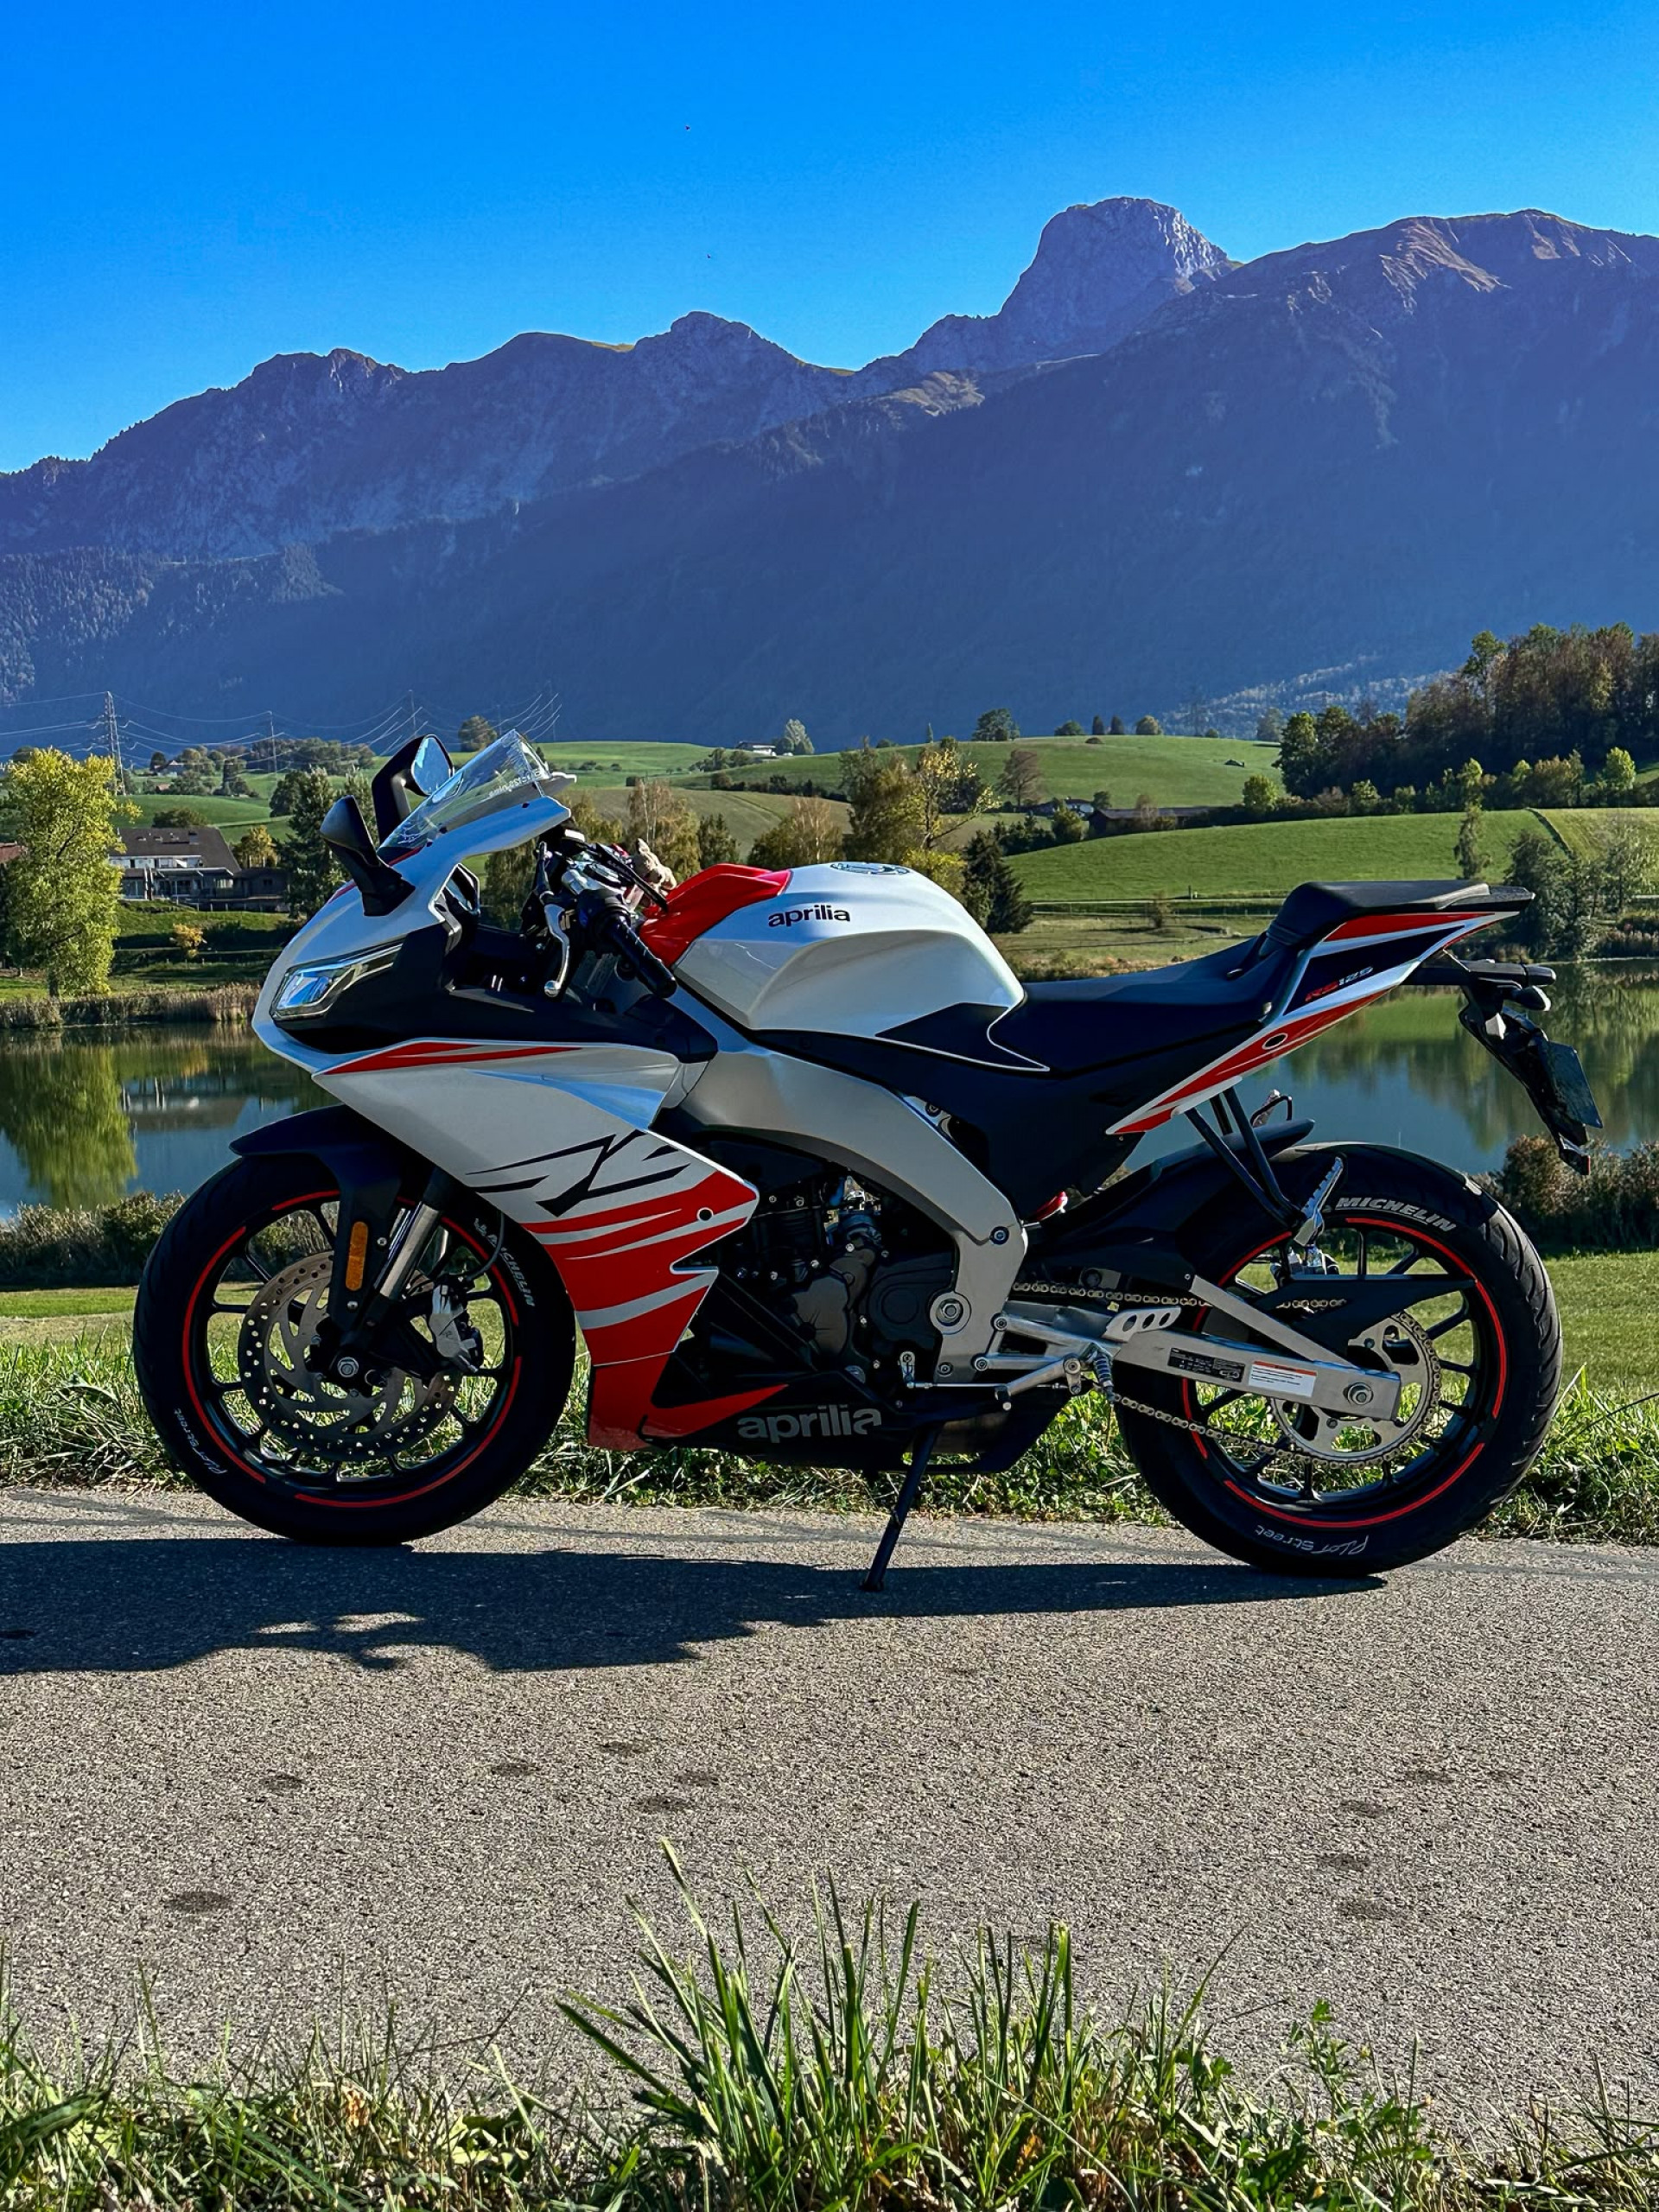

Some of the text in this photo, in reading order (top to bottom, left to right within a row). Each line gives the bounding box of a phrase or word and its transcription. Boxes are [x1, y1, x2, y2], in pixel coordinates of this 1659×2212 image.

[768, 905, 851, 928] aprilia
[1336, 1197, 1457, 1232] MICHELIN
[737, 1404, 882, 1444] aprilia
[1255, 1524, 1314, 1552] Street
